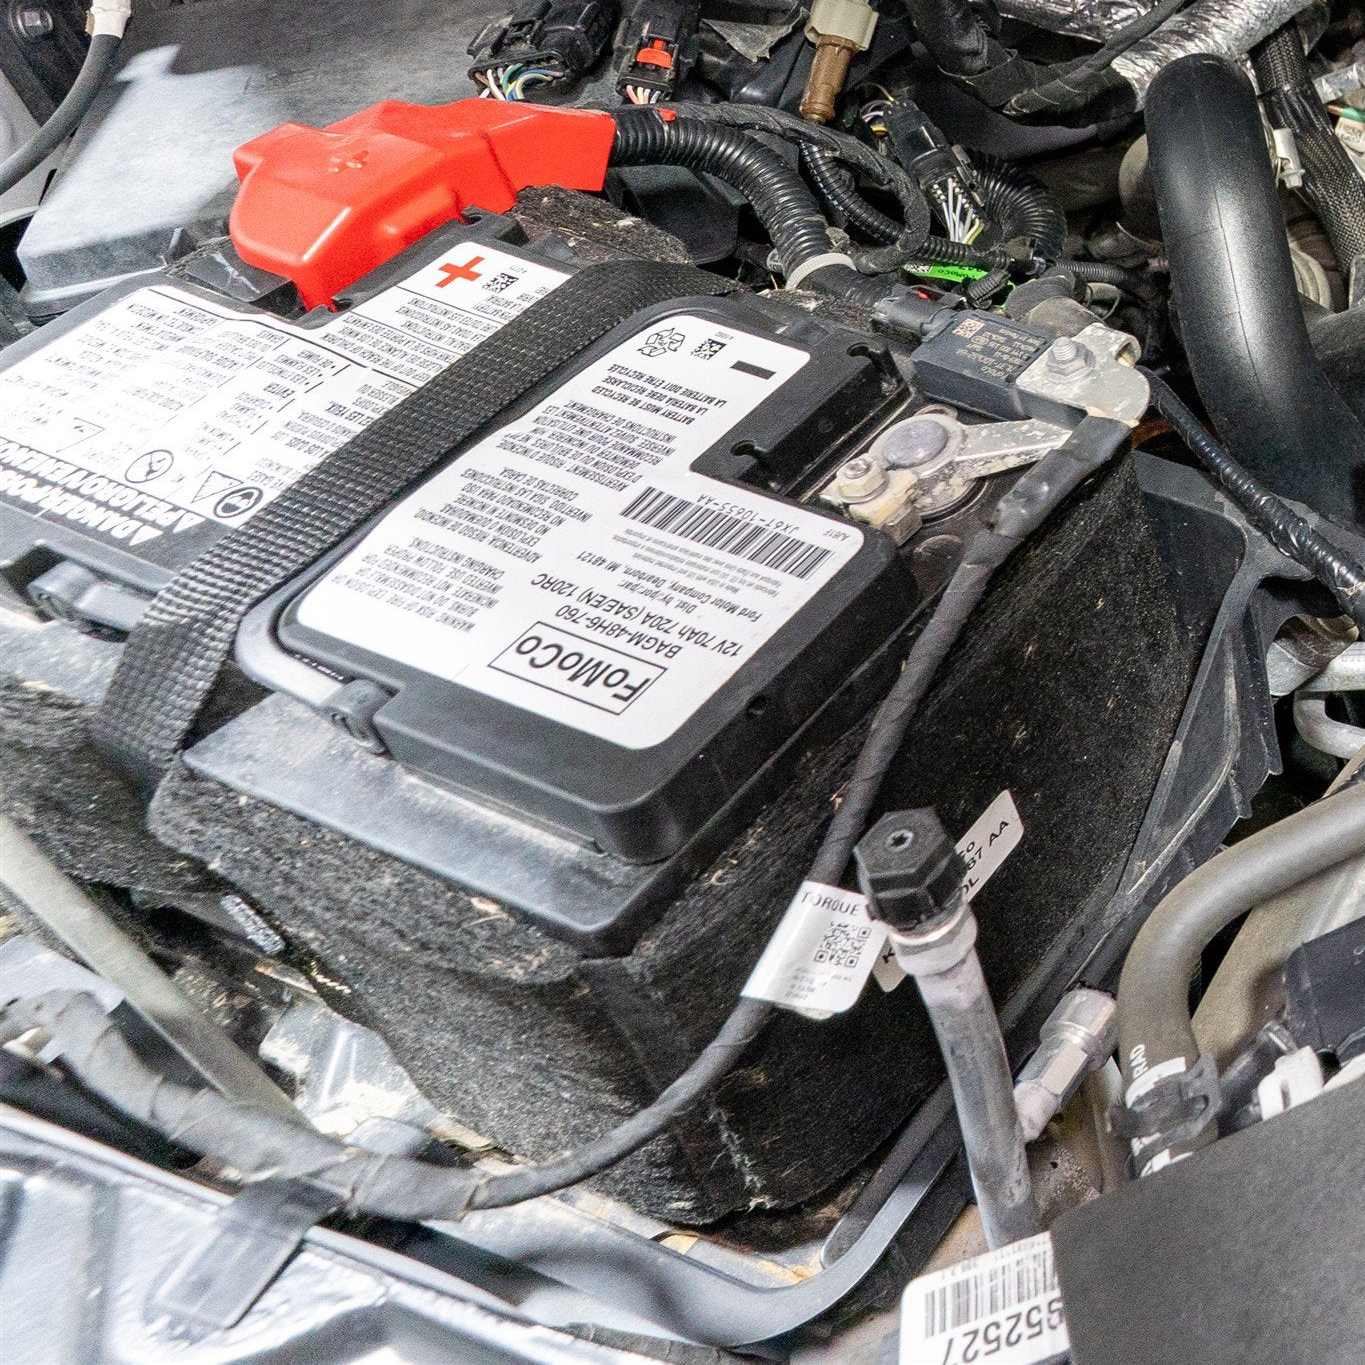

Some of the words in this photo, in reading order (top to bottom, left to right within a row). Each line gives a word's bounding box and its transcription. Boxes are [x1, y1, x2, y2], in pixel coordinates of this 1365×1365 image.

[273, 352, 307, 370] FLAMMES
[295, 348, 323, 363] FUMER
[302, 364, 321, 376] LES
[606, 362, 647, 381] RECYCLÉE
[289, 373, 308, 384] LES
[601, 374, 648, 395] RECICLARSE
[641, 374, 666, 387] ÊTRE
[590, 384, 631, 403] RECYCLED
[644, 389, 668, 401] DEBE
[660, 381, 683, 393] DOIT
[627, 397, 642, 406] BE
[663, 396, 698, 412] BATERÍA
[678, 387, 717, 405] BATTERIE
[712, 398, 727, 408] LA
[344, 409, 365, 422] LES
[541, 405, 558, 415] LES
[638, 401, 663, 414] MUST
[694, 406, 708, 415] LA
[553, 409, 613, 435] ATTENTIVEMENT
[659, 408, 695, 425] BATTERY
[571, 428, 591, 439] UNE
[586, 433, 611, 447] POUR
[607, 428, 639, 444] SUIVEZ
[622, 420, 676, 444] INSTRUCTIONS
[303, 443, 324, 456] LOS
[606, 441, 663, 465] RECOMMANDÉ
[535, 453, 567, 469] RISQUE
[595, 449, 640, 470] DÉMONTER
[565, 463, 630, 491] AVERTISSEMENT
[590, 459, 643, 483] D'EXPLOSION
[459, 467, 519, 494] INSTRUCCIONES
[460, 481, 482, 494] USO
[521, 475, 537, 486] DE
[476, 487, 500, 501] PARA
[513, 487, 533, 499] LAS
[532, 479, 579, 501] CORRECTAS
[527, 492, 550, 506] SIGA
[485, 505, 500, 515] NI
[494, 494, 554, 521] RECOMENDADO
[694, 493, 799, 535] JX6T-10655-AA
[446, 520, 463, 532] DE
[486, 521, 499, 530] O
[494, 508, 539, 530] DESMONTE
[549, 514, 567, 526] NO
[456, 524, 490, 542] RIESGO
[534, 523, 552, 535] NO
[822, 528, 850, 542] AJ61F
[359, 551, 381, 565] FOR
[382, 543, 417, 562] PROPER
[575, 549, 609, 566] 48121
[354, 565, 372, 577] OR
[411, 554, 448, 573] FOLLOW
[459, 557, 506, 580] CHARGING
[603, 559, 622, 571] MI
[376, 558, 438, 586] RECOMMENDED
[617, 564, 667, 587] Dearborn,
[342, 576, 389, 599] EXPLOSION
[366, 570, 422, 596] DISASSEMBLE
[431, 578, 454, 592] NOT
[460, 573, 503, 594] INVERTED
[528, 570, 582, 598] 120RC
[704, 577, 720, 587] USA
[416, 589, 438, 602] NOT
[431, 595, 450, 606] DO
[663, 581, 713, 604] Company,
[401, 599, 420, 611] OF
[414, 604, 438, 618] RISK
[574, 587, 646, 621] (SAE/EN)
[672, 599, 698, 613] Dist.
[708, 597, 741, 614] Motor
[636, 610, 681, 634] 720A
[735, 606, 763, 622] Ford
[552, 604, 683, 658] BAGM-48H6-760
[673, 624, 718, 648] 70Ah
[710, 637, 746, 658] 12V
[514, 633, 651, 702] FoMoCo
[801, 891, 863, 918] TORQUE
[1129, 1044, 1149, 1080] RAD
